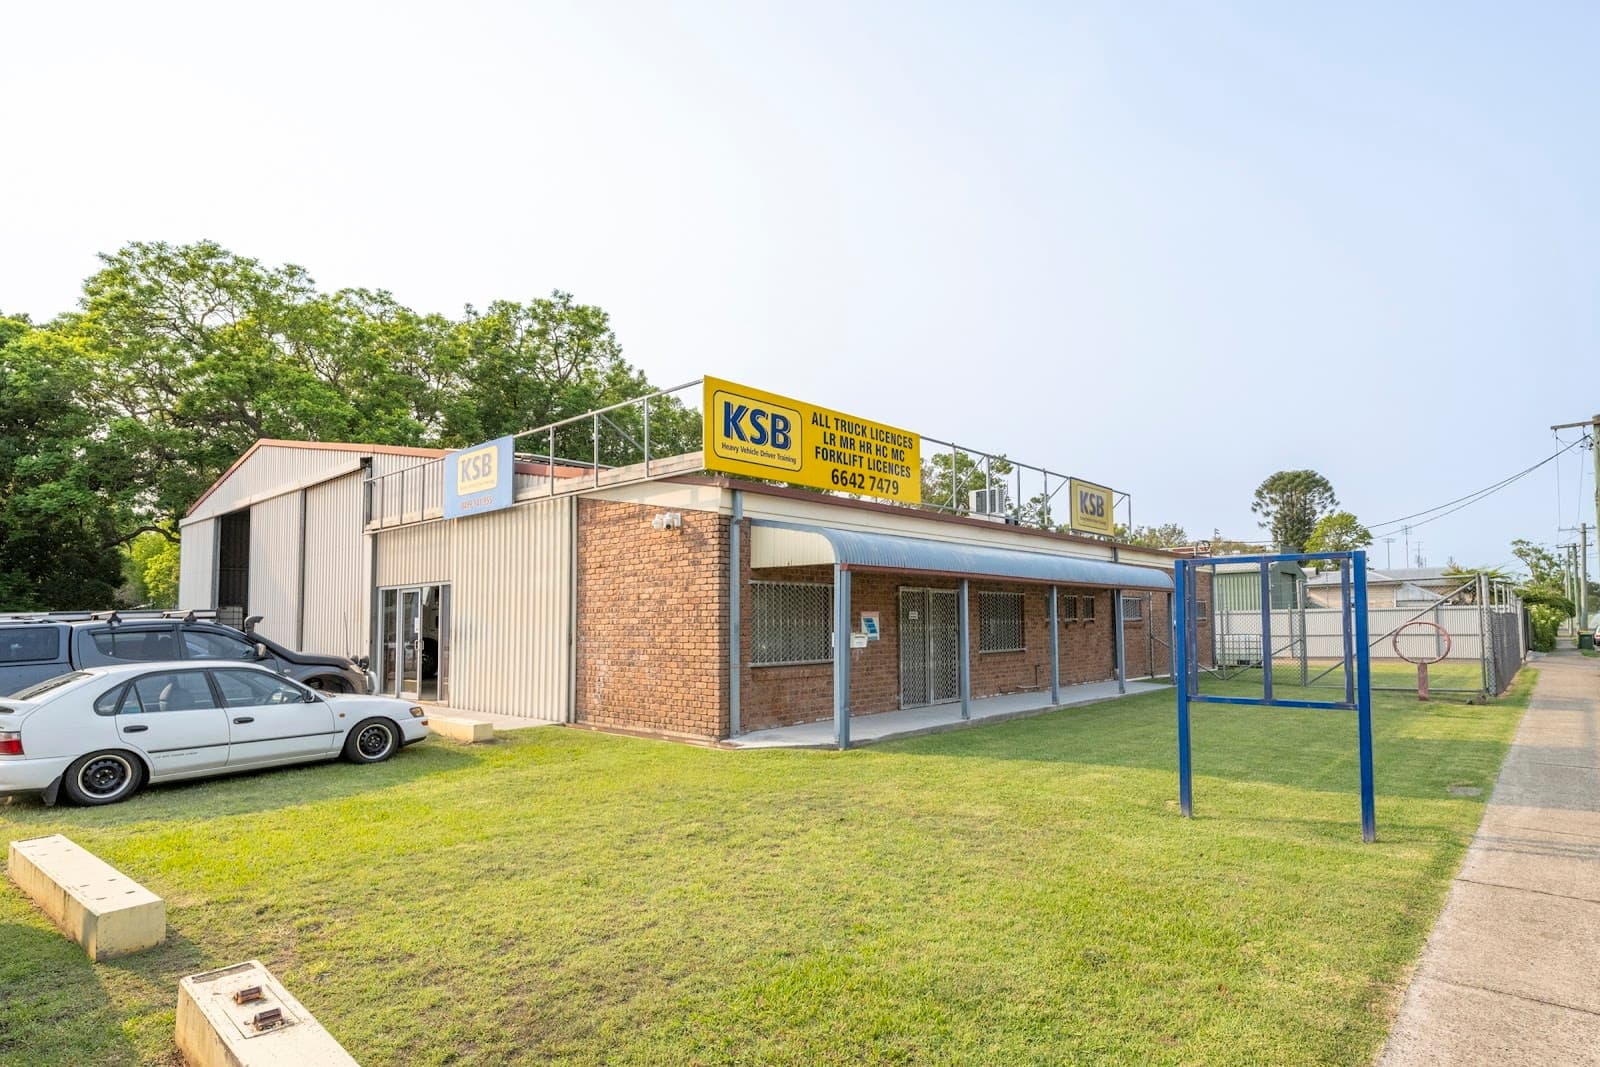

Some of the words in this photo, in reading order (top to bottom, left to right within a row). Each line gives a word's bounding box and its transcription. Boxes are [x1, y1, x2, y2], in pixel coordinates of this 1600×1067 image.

[724, 401, 791, 450] KSB
[811, 412, 830, 428] ALL
[834, 417, 867, 438] TRUCK
[870, 427, 913, 449] LICENCES
[721, 442, 739, 453] Heavy
[741, 446, 759, 456] Vehicle
[760, 450, 776, 459] Driver
[777, 453, 797, 464] Training
[823, 431, 836, 446] LR
[840, 435, 855, 451] MR
[859, 440, 872, 455] HR
[875, 444, 888, 458] HC
[892, 448, 905, 462] MC
[461, 453, 492, 482] KSB
[815, 446, 864, 468] FORKLIFT
[867, 457, 911, 478] LICENCES
[831, 468, 865, 489] 6642
[869, 476, 899, 495] 7479
[1080, 490, 1104, 517] KSB
